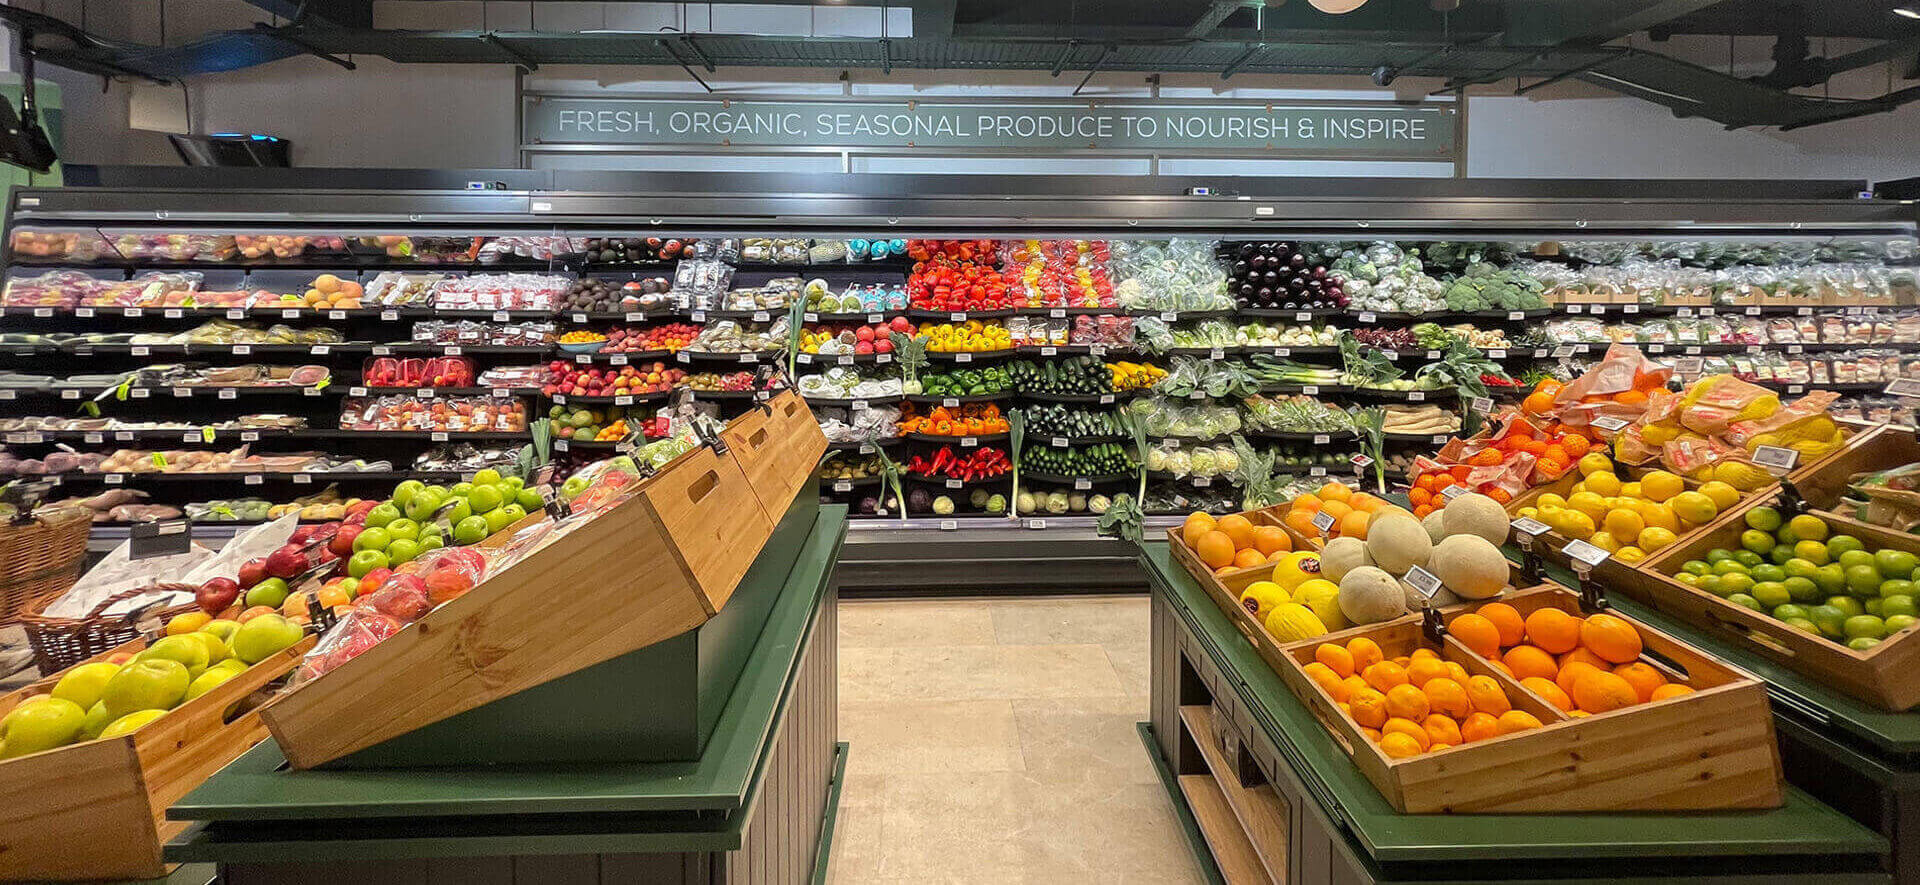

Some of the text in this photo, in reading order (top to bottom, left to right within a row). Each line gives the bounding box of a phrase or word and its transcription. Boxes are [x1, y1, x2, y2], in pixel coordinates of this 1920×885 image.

[559, 110, 1426, 141] FRESH, ORGANIC, SEASONAL PRODUCE TO NOURISH & INSPIRE
